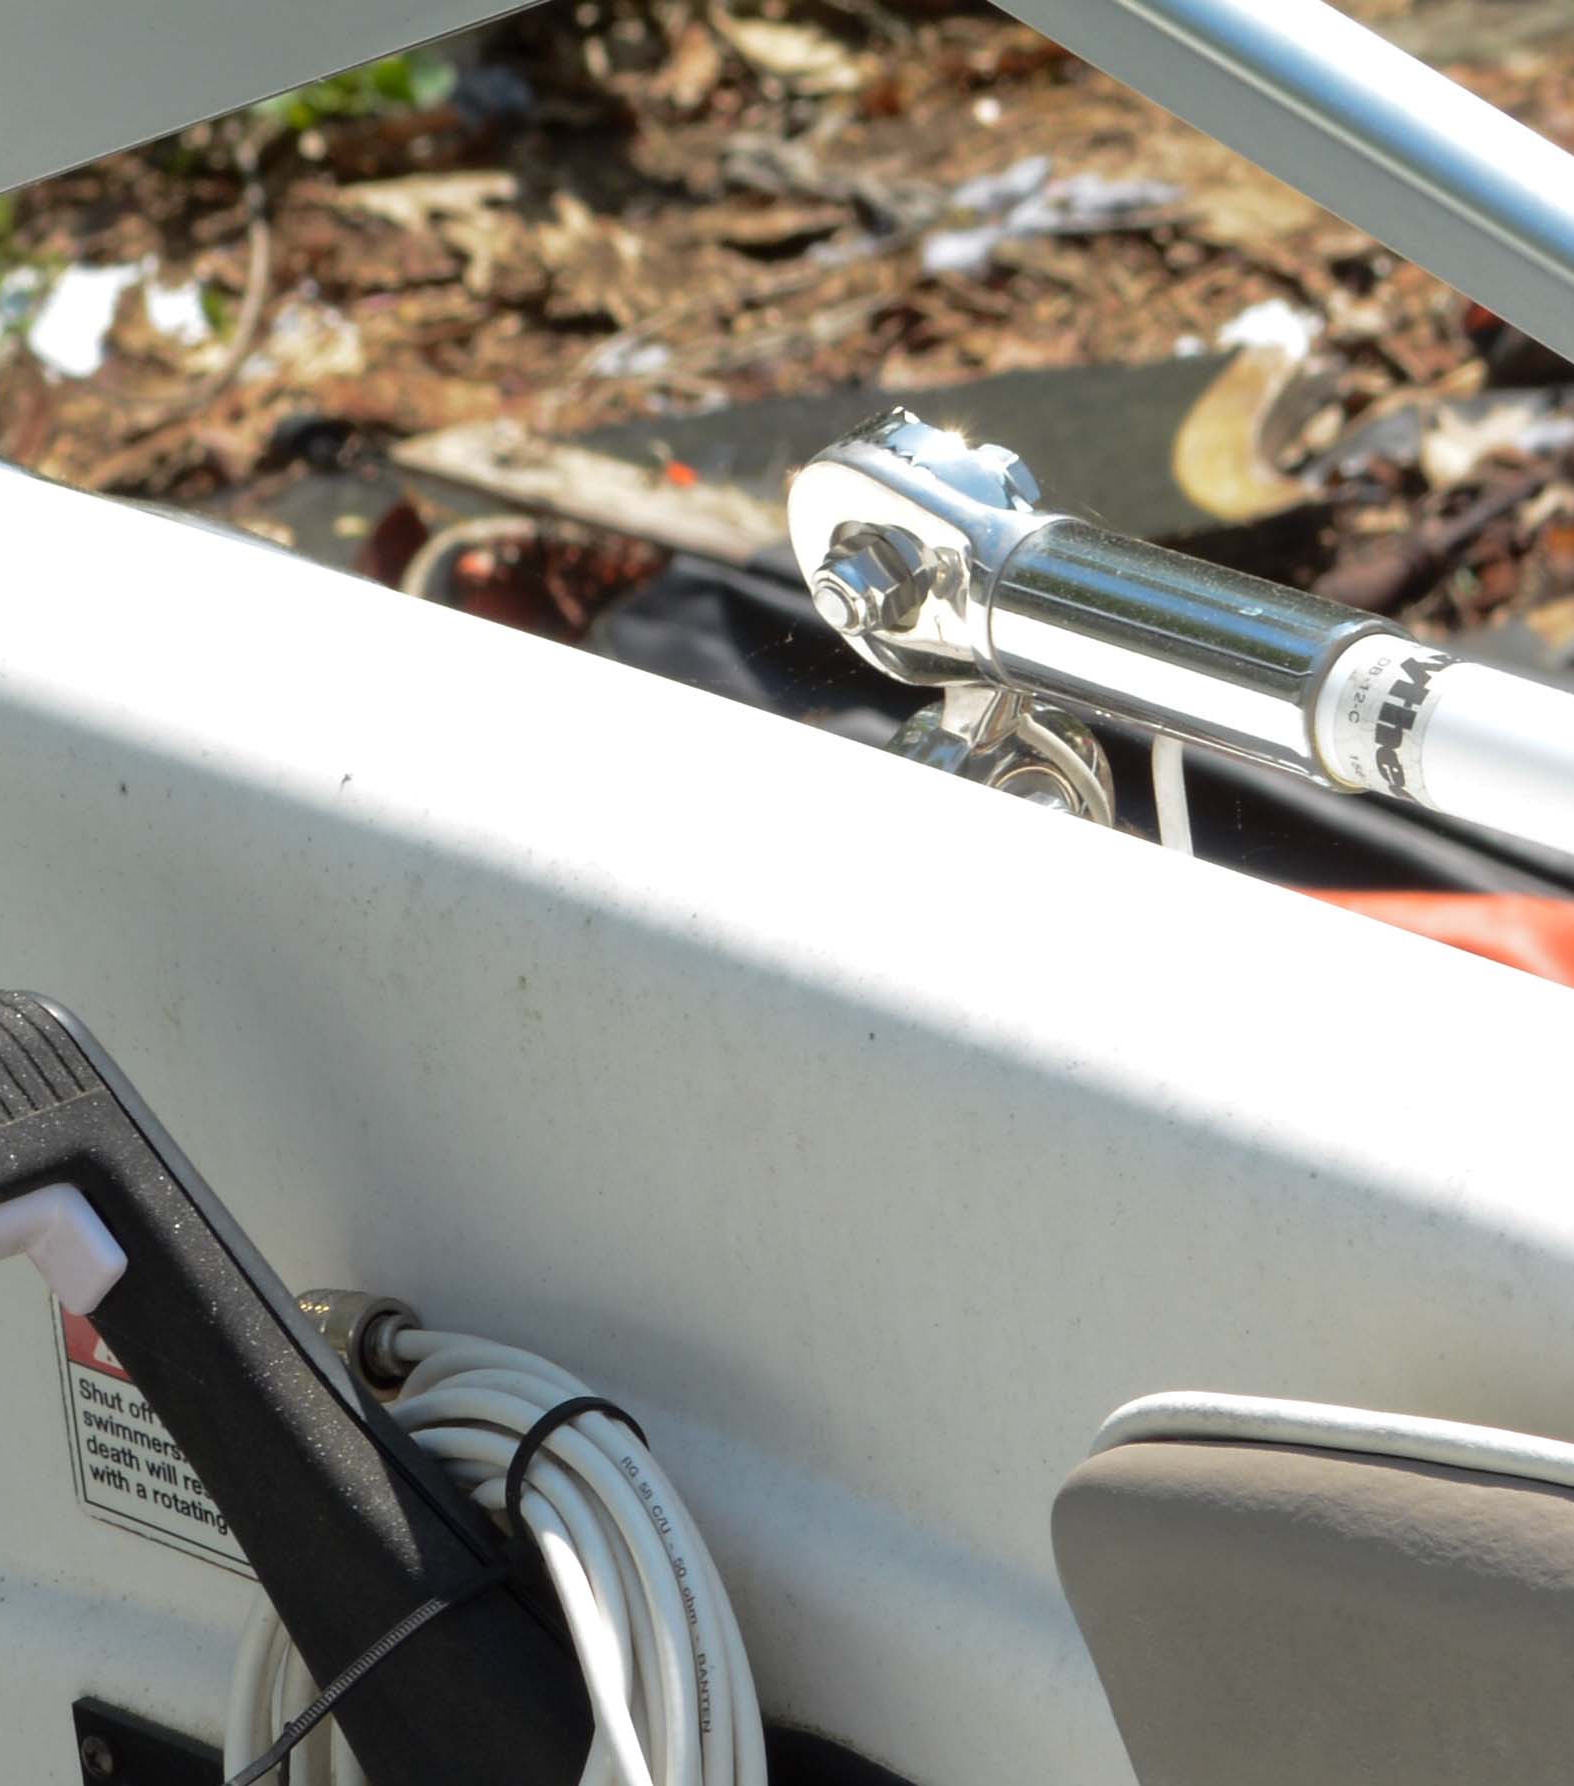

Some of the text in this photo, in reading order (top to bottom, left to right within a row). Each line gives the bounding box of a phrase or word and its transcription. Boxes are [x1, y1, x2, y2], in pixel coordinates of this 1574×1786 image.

[78, 1378, 124, 1414] Shut
[86, 1436, 140, 1472] death
[146, 1457, 178, 1486] will
[90, 1463, 228, 1536] with a rotating
